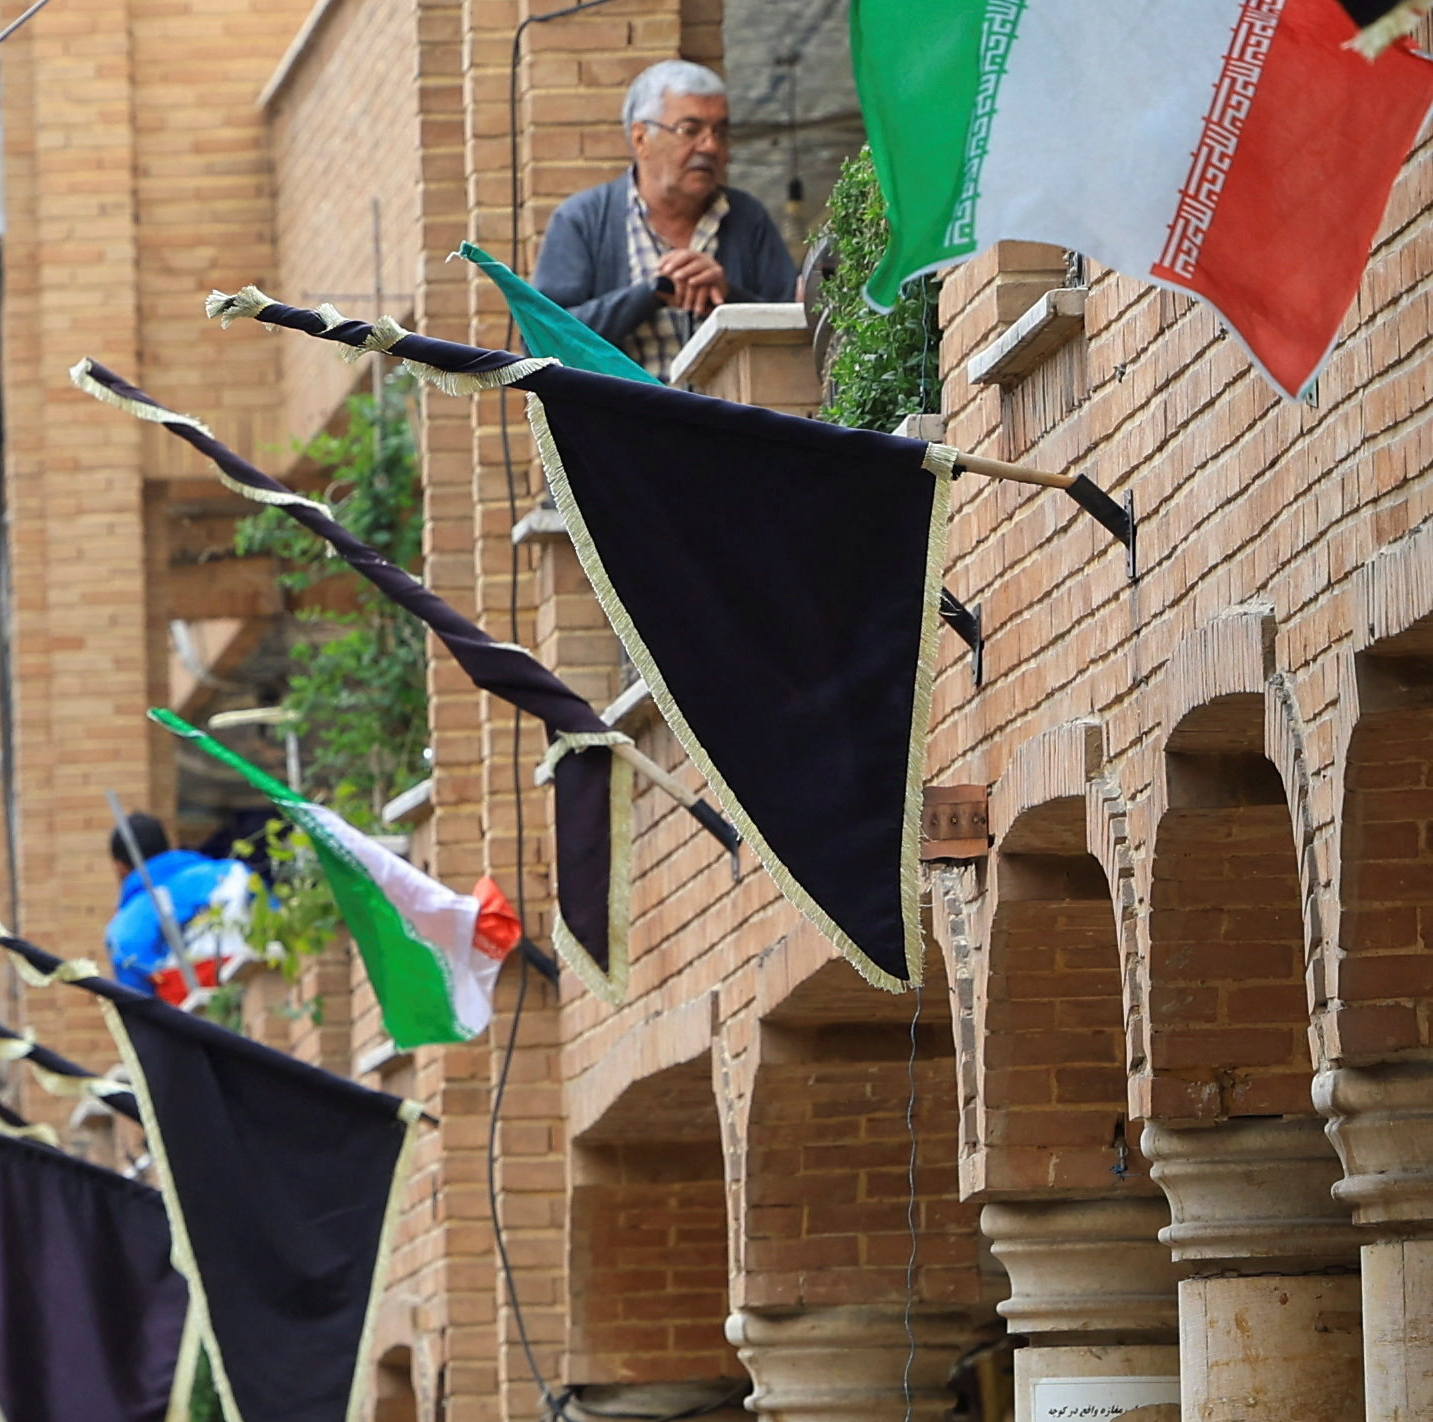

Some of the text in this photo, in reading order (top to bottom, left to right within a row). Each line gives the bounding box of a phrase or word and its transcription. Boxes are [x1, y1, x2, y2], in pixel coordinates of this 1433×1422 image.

[1048, 1405, 1068, 1418] کوچه
[1067, 1407, 1079, 1418] در
[1079, 1404, 1099, 1418] واقع
